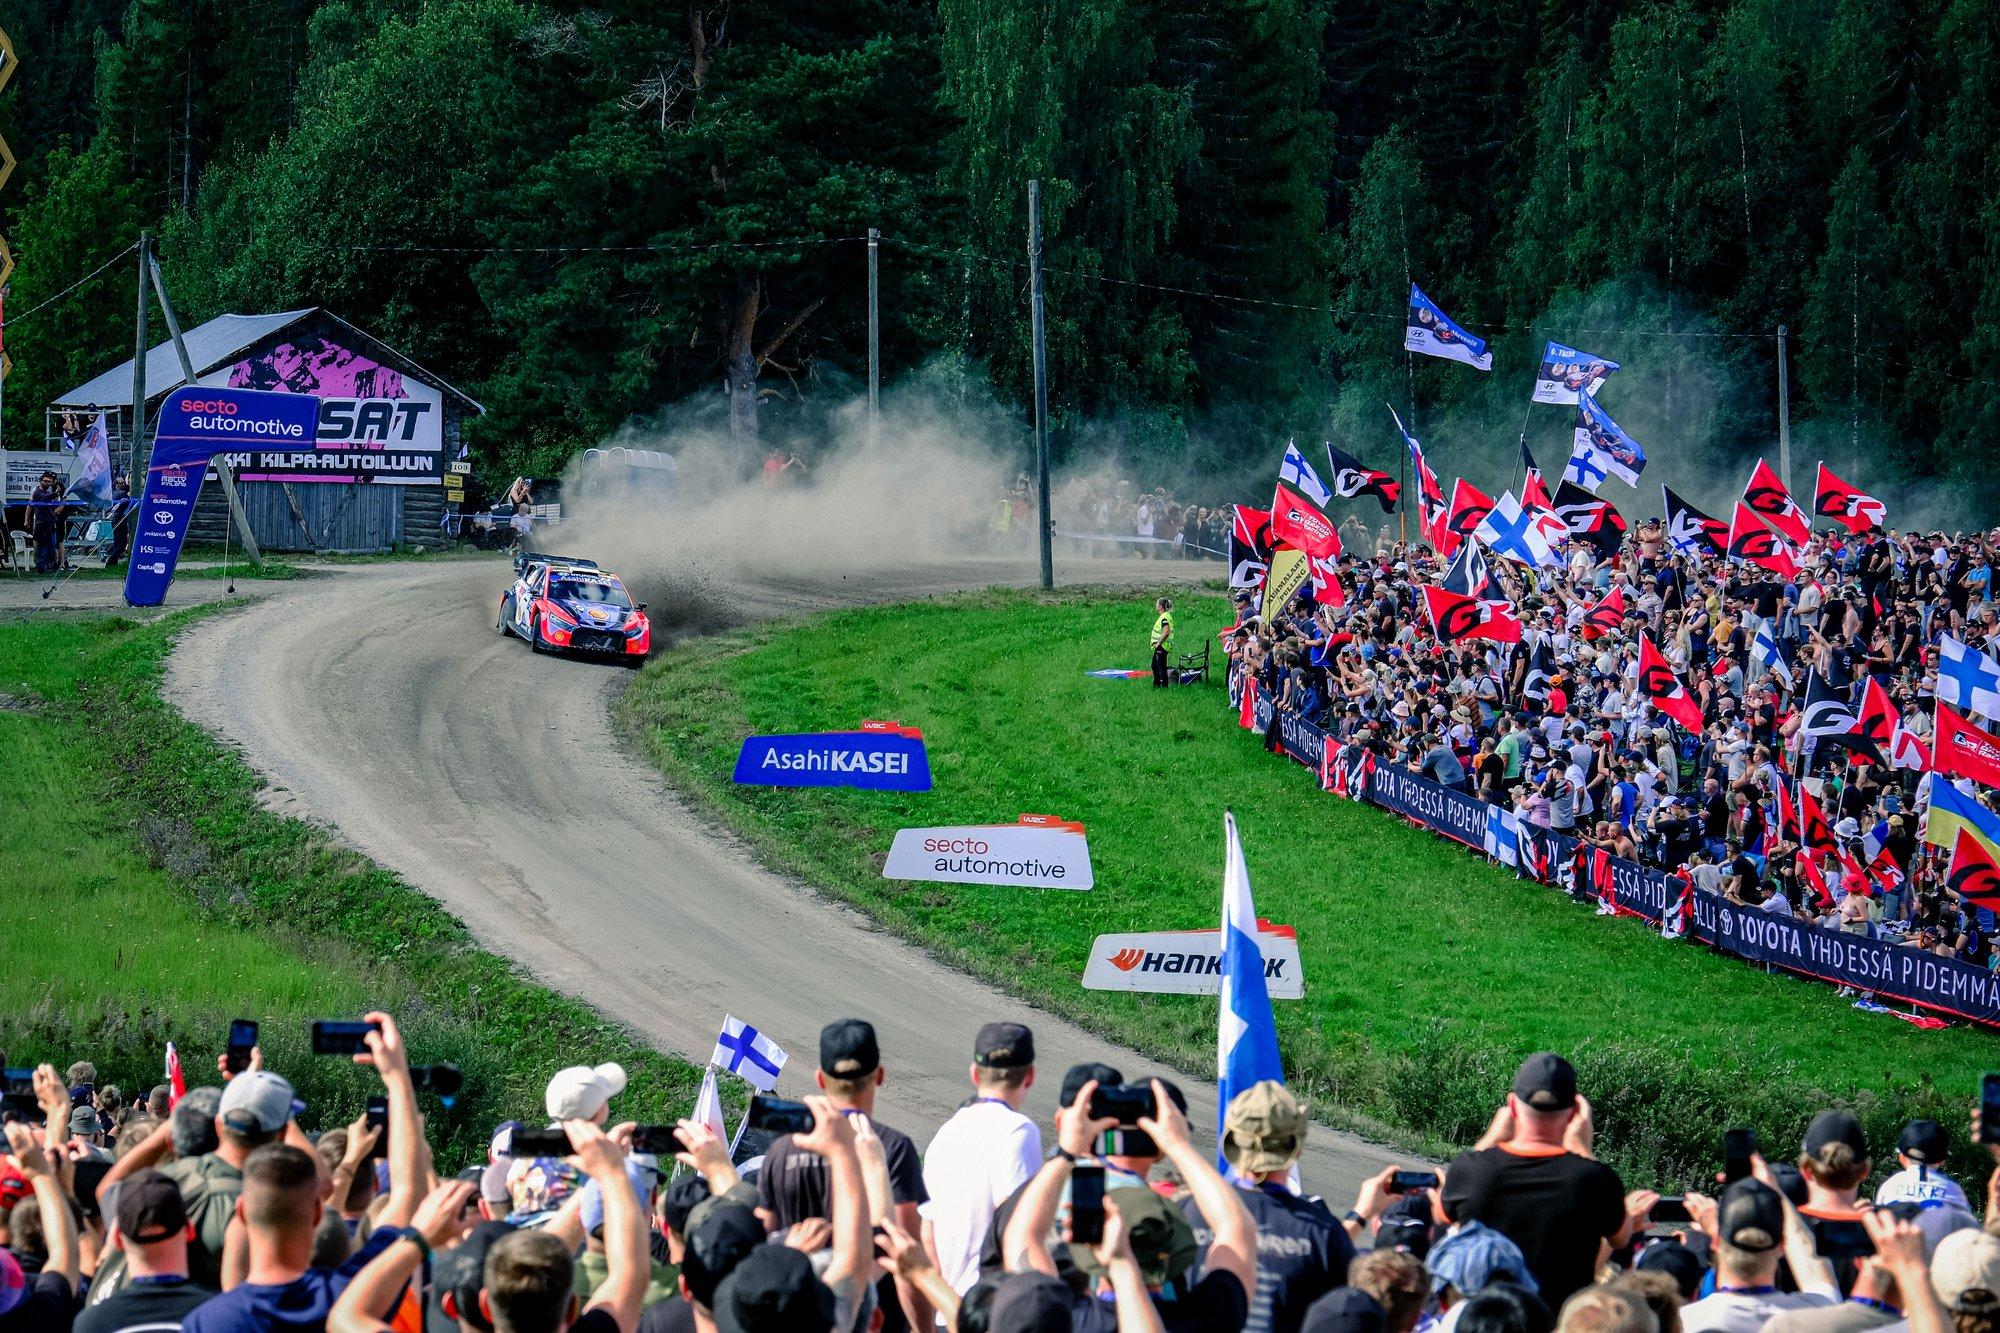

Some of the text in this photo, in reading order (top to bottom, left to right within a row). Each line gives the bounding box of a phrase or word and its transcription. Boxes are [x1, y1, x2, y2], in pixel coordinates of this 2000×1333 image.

[181, 399, 237, 415] secto
[190, 415, 303, 437] automotive
[261, 453, 432, 471] KILPA-AUTOILUUN
[1816, 490, 1888, 525] GR
[140, 545, 154, 553] KS
[1280, 569, 1306, 601] PULLING
[761, 747, 908, 774] AsahiKASEI
[1399, 775, 1445, 820] YHDESSÄ
[924, 837, 988, 854] secto
[934, 856, 1066, 879] automotive
[1738, 914, 1802, 957] TOYOTA
[1808, 932, 1894, 981] YHDESSÄ
